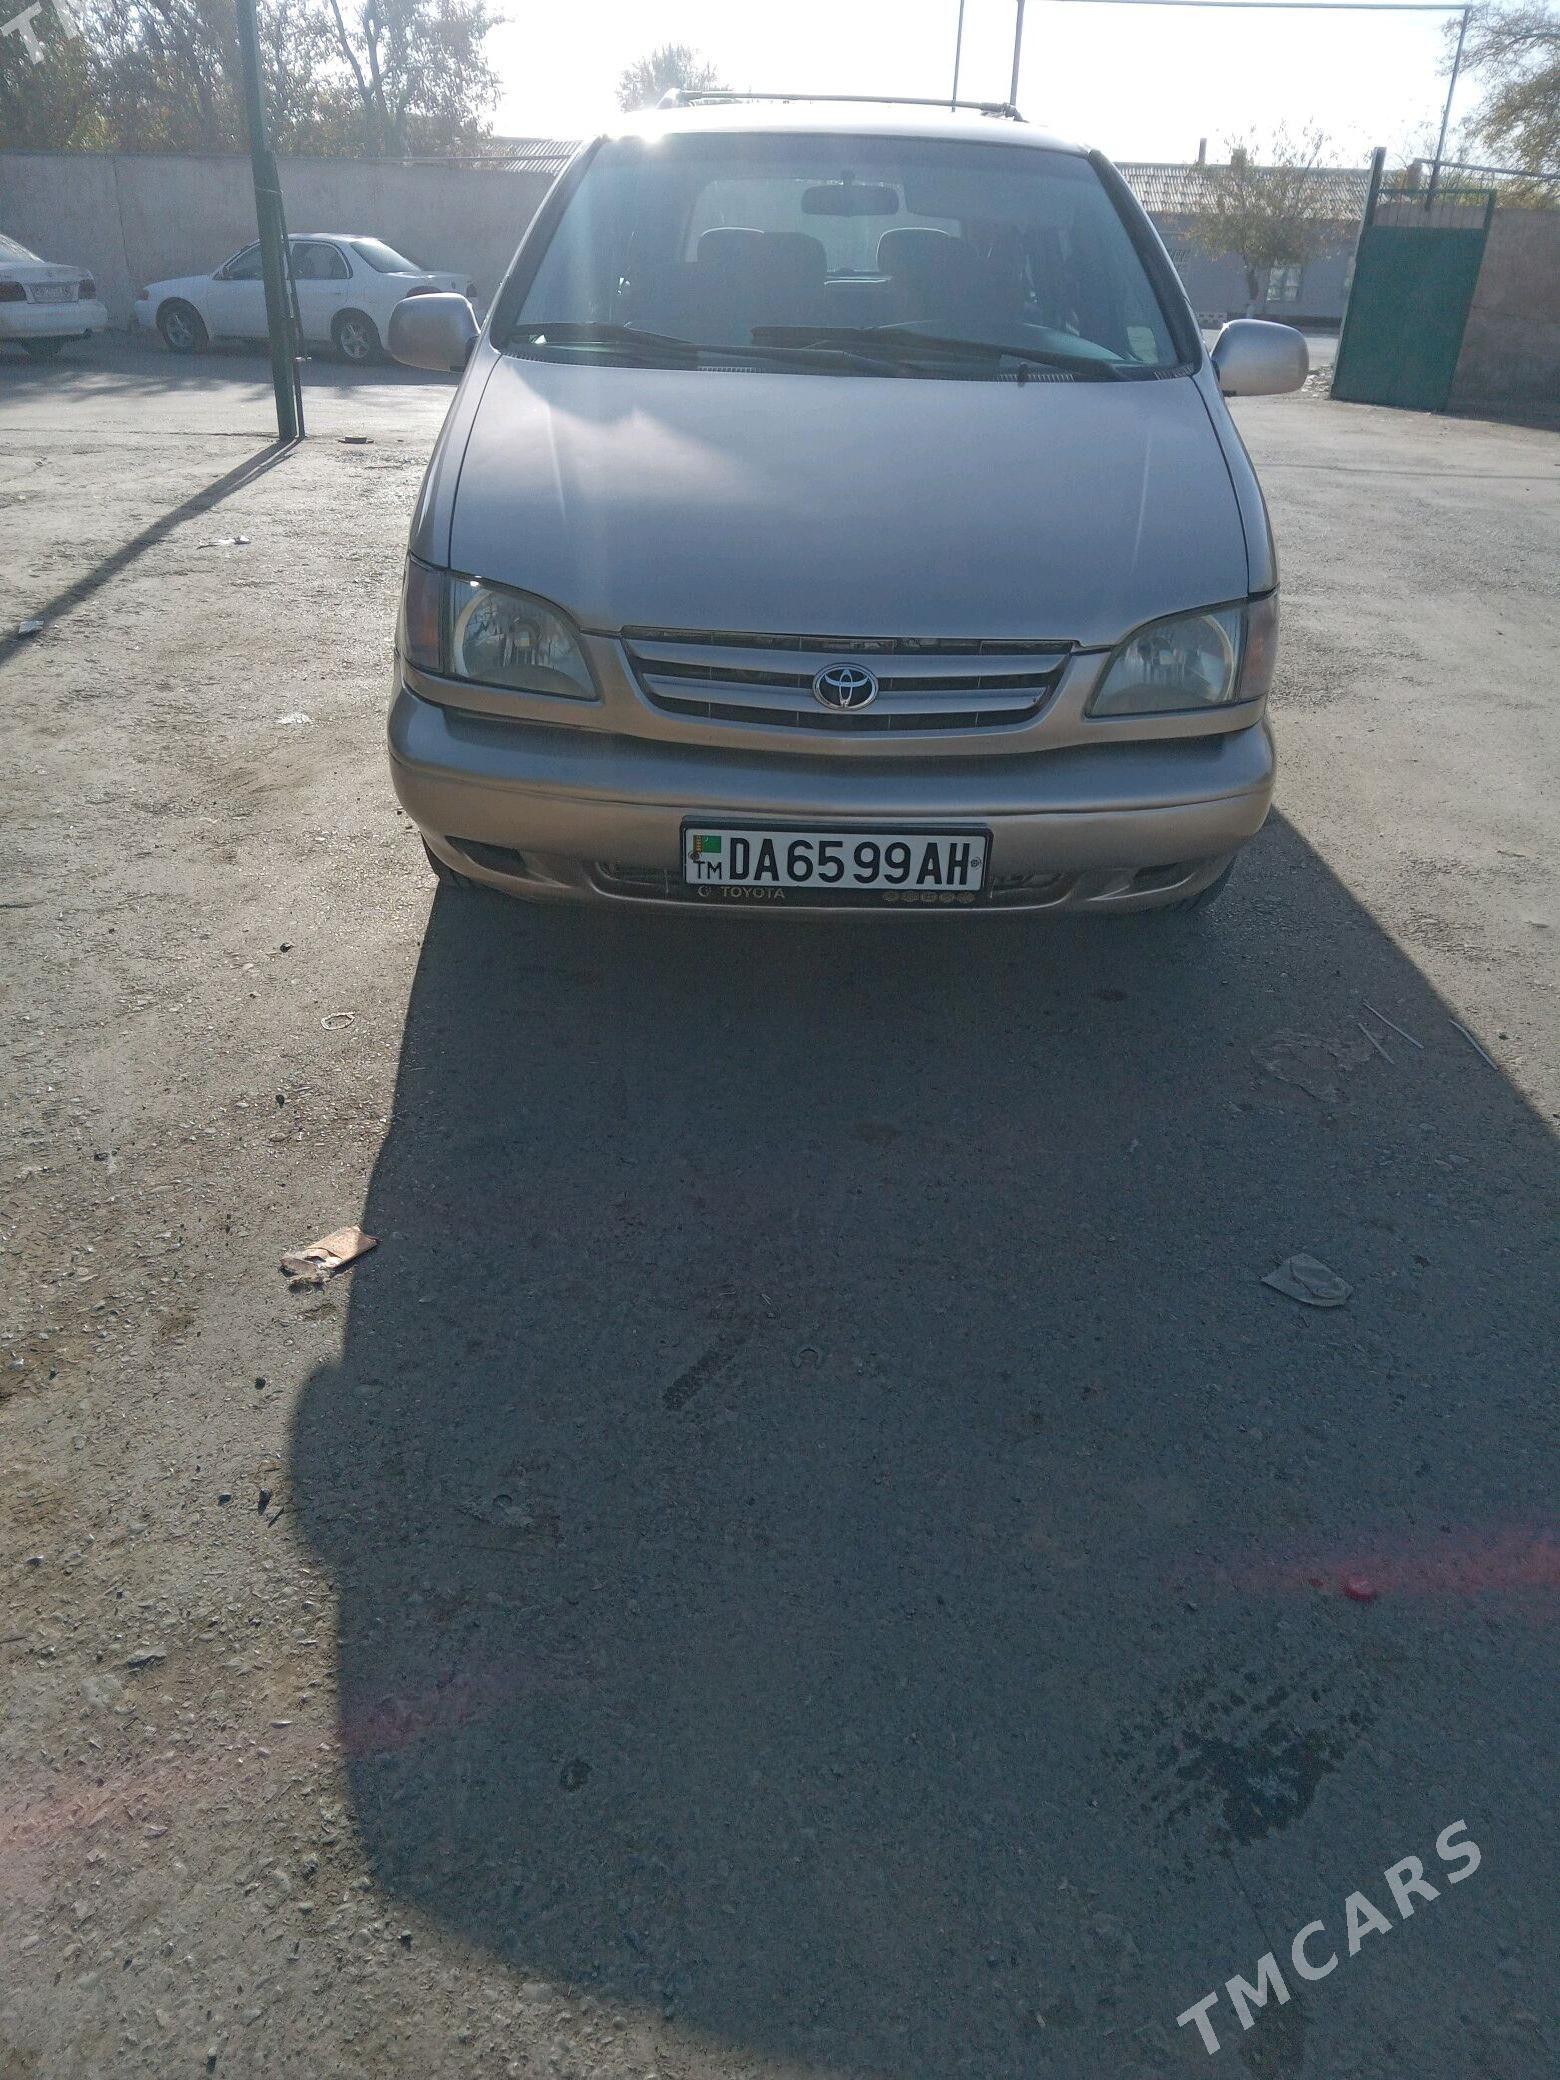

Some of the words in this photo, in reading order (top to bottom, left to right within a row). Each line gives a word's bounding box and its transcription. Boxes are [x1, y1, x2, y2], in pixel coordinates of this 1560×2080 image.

[693, 860, 722, 880] TM
[729, 837, 971, 885] DA6599AH
[720, 885, 786, 899] TOYOTA
